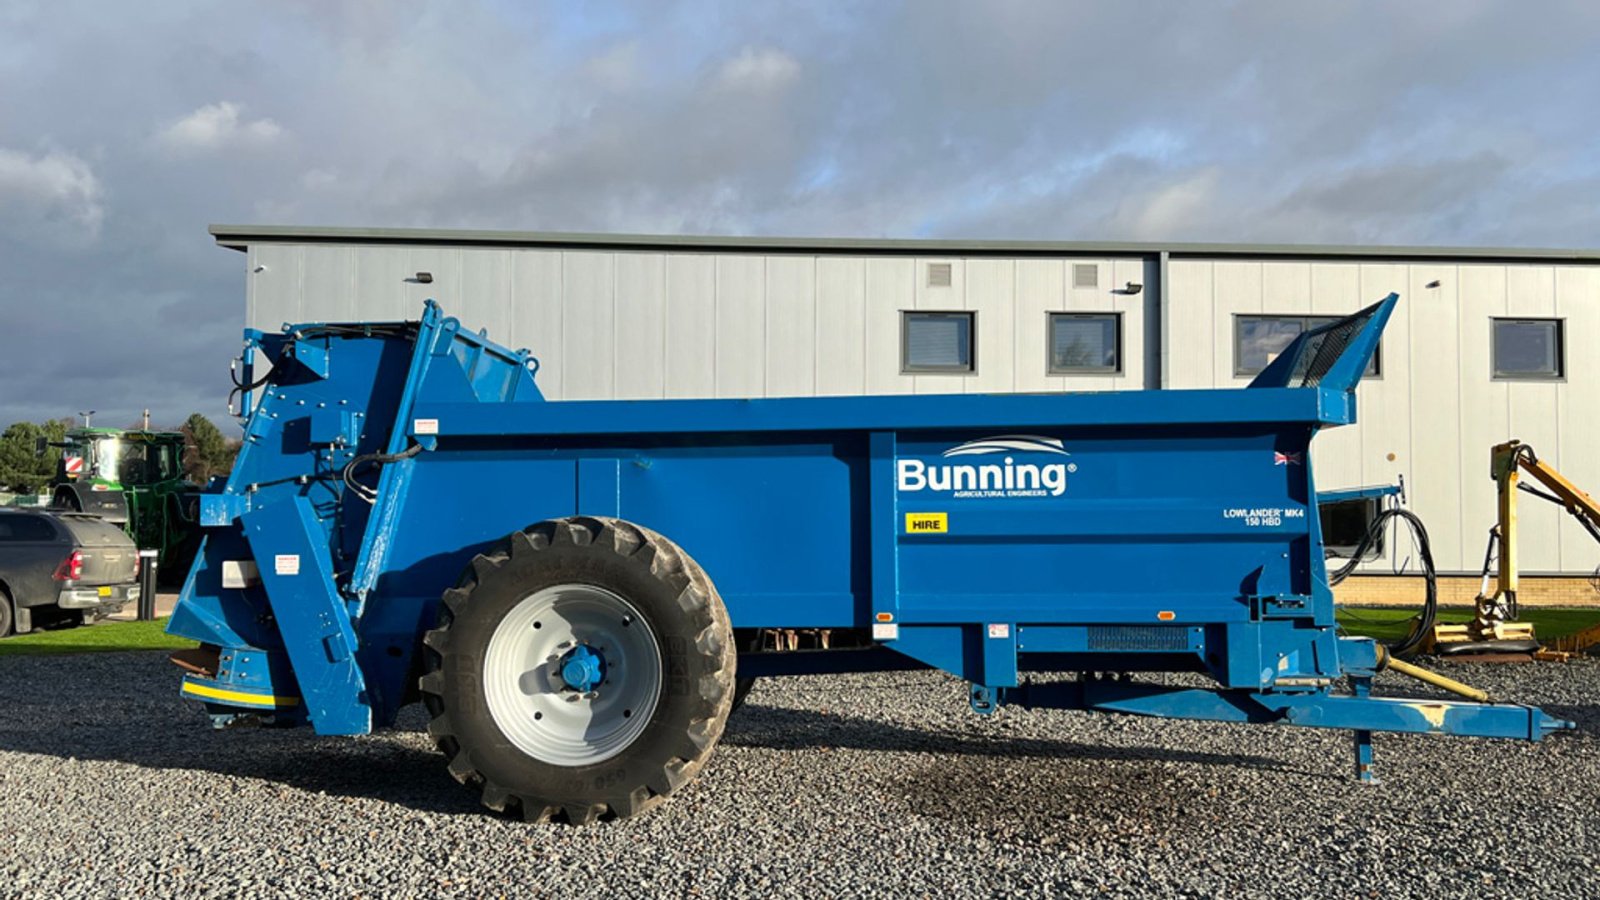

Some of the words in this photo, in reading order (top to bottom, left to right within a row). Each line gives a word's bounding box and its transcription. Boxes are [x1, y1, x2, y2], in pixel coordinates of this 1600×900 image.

[953, 490, 1005, 498] AGRICULTURAL
[1007, 489, 1048, 497] ENGINEERS
[1284, 508, 1304, 517] MK4
[912, 520, 941, 530] HIRE
[1245, 517, 1260, 526] 150
[1262, 517, 1281, 526] HBD
